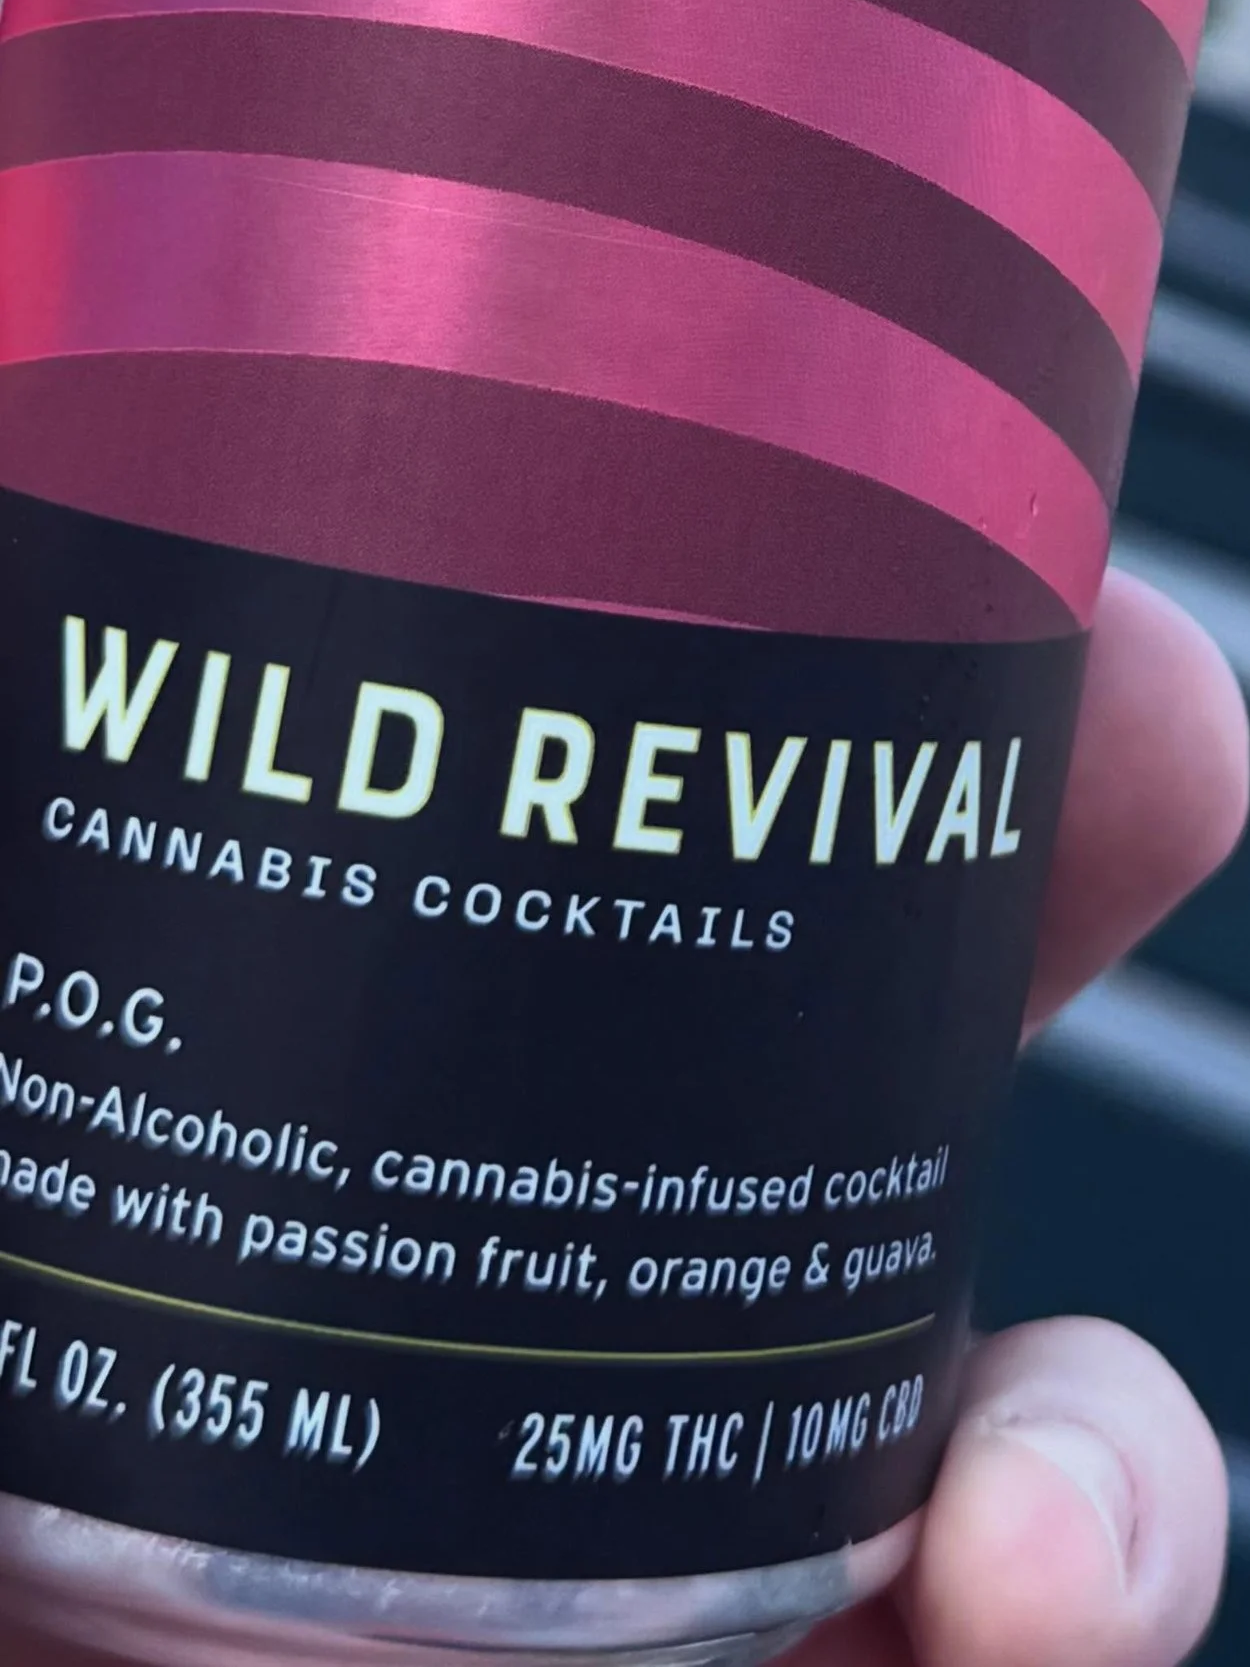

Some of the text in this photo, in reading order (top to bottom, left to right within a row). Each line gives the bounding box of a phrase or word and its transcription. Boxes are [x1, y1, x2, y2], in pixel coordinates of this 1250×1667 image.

[63, 614, 1022, 865] WILD REVIVAL
[42, 796, 796, 950] CANNABIS COCKTAILS
[4, 951, 183, 1052] P.O.G.
[0, 1051, 950, 1214] Non-Alcoholic, cannabis-infused cocktail
[112, 1181, 225, 1247] with
[237, 1213, 457, 1286] passion
[476, 1236, 609, 1302] fruit,
[627, 1254, 792, 1308] orange
[802, 1241, 830, 1291] &
[842, 1230, 937, 1296] guava.
[54, 1339, 128, 1422] OZ.
[148, 1362, 271, 1448] (355
[284, 1385, 382, 1474] ML)
[509, 1412, 644, 1484] 25MG
[663, 1412, 745, 1482] THC
[785, 1391, 871, 1470] 10MG
[877, 1374, 925, 1442] CBD
